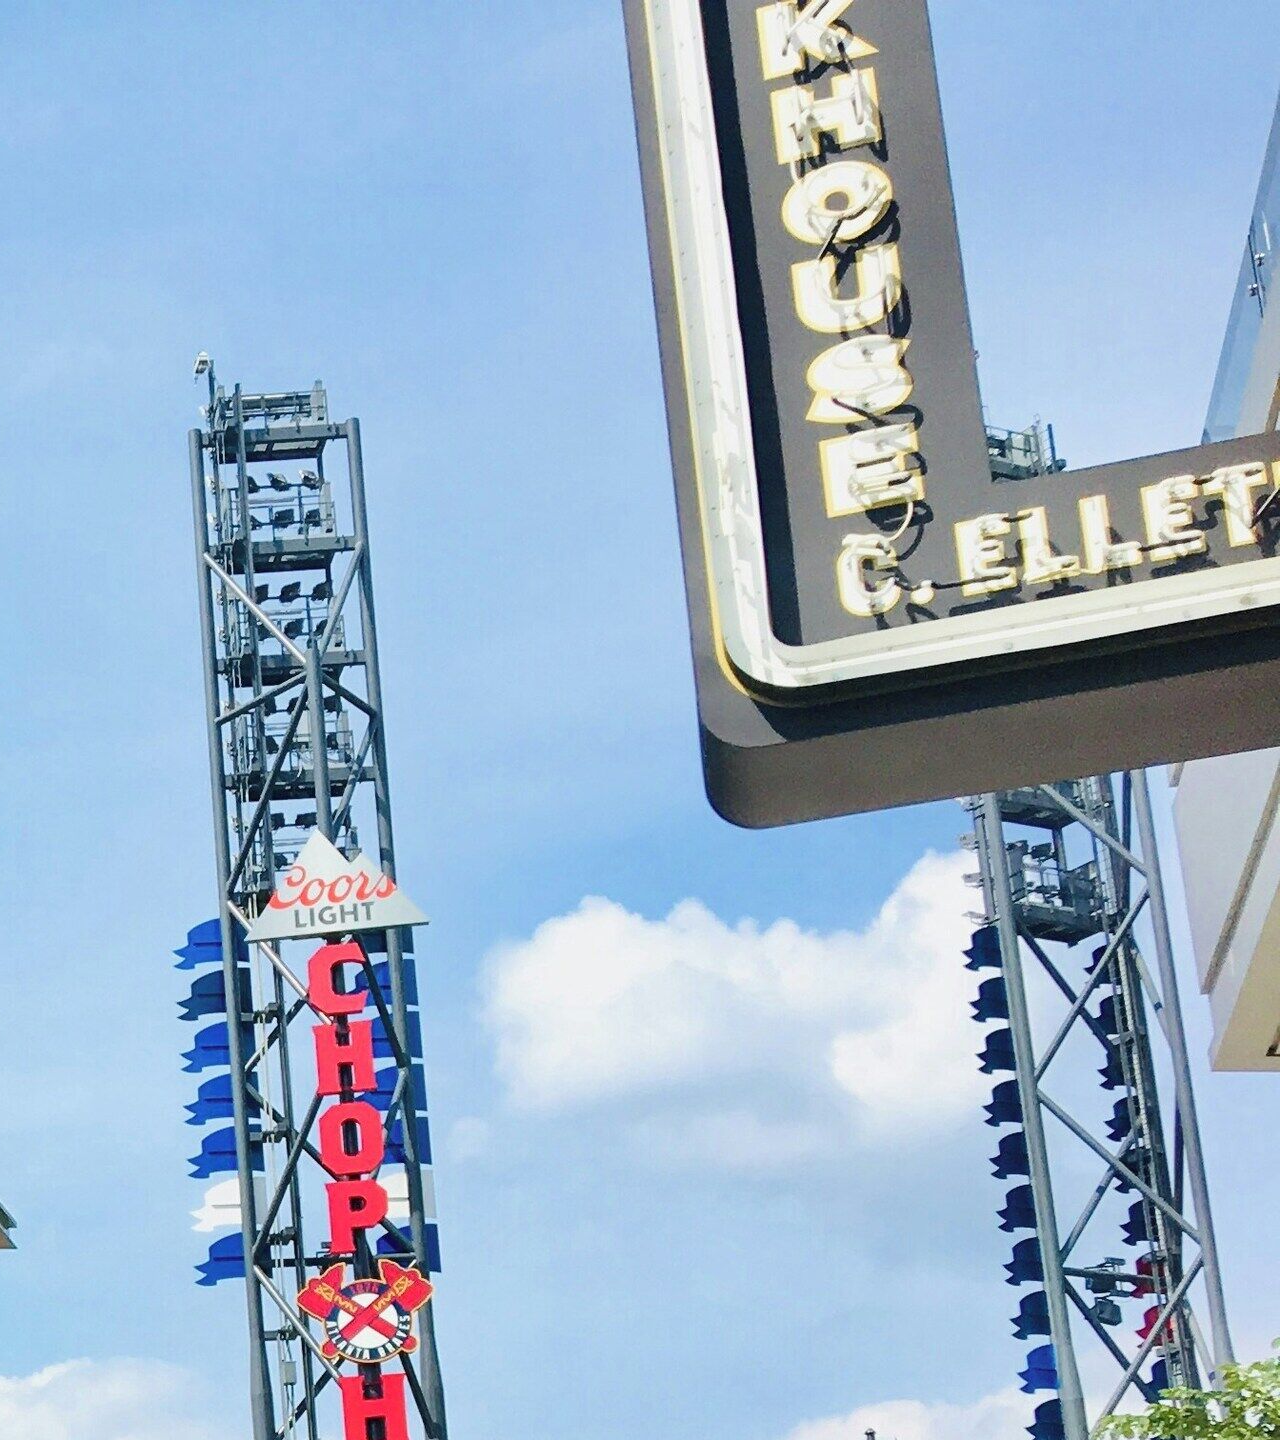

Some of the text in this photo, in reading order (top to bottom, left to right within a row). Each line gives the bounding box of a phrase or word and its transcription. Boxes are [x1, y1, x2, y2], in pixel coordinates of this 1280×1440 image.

[269, 865, 398, 910] Coors
[294, 901, 374, 928] LIGHT
[307, 940, 389, 1254] CHOP
[325, 1313, 411, 1360] ATLANTA BRAVES
